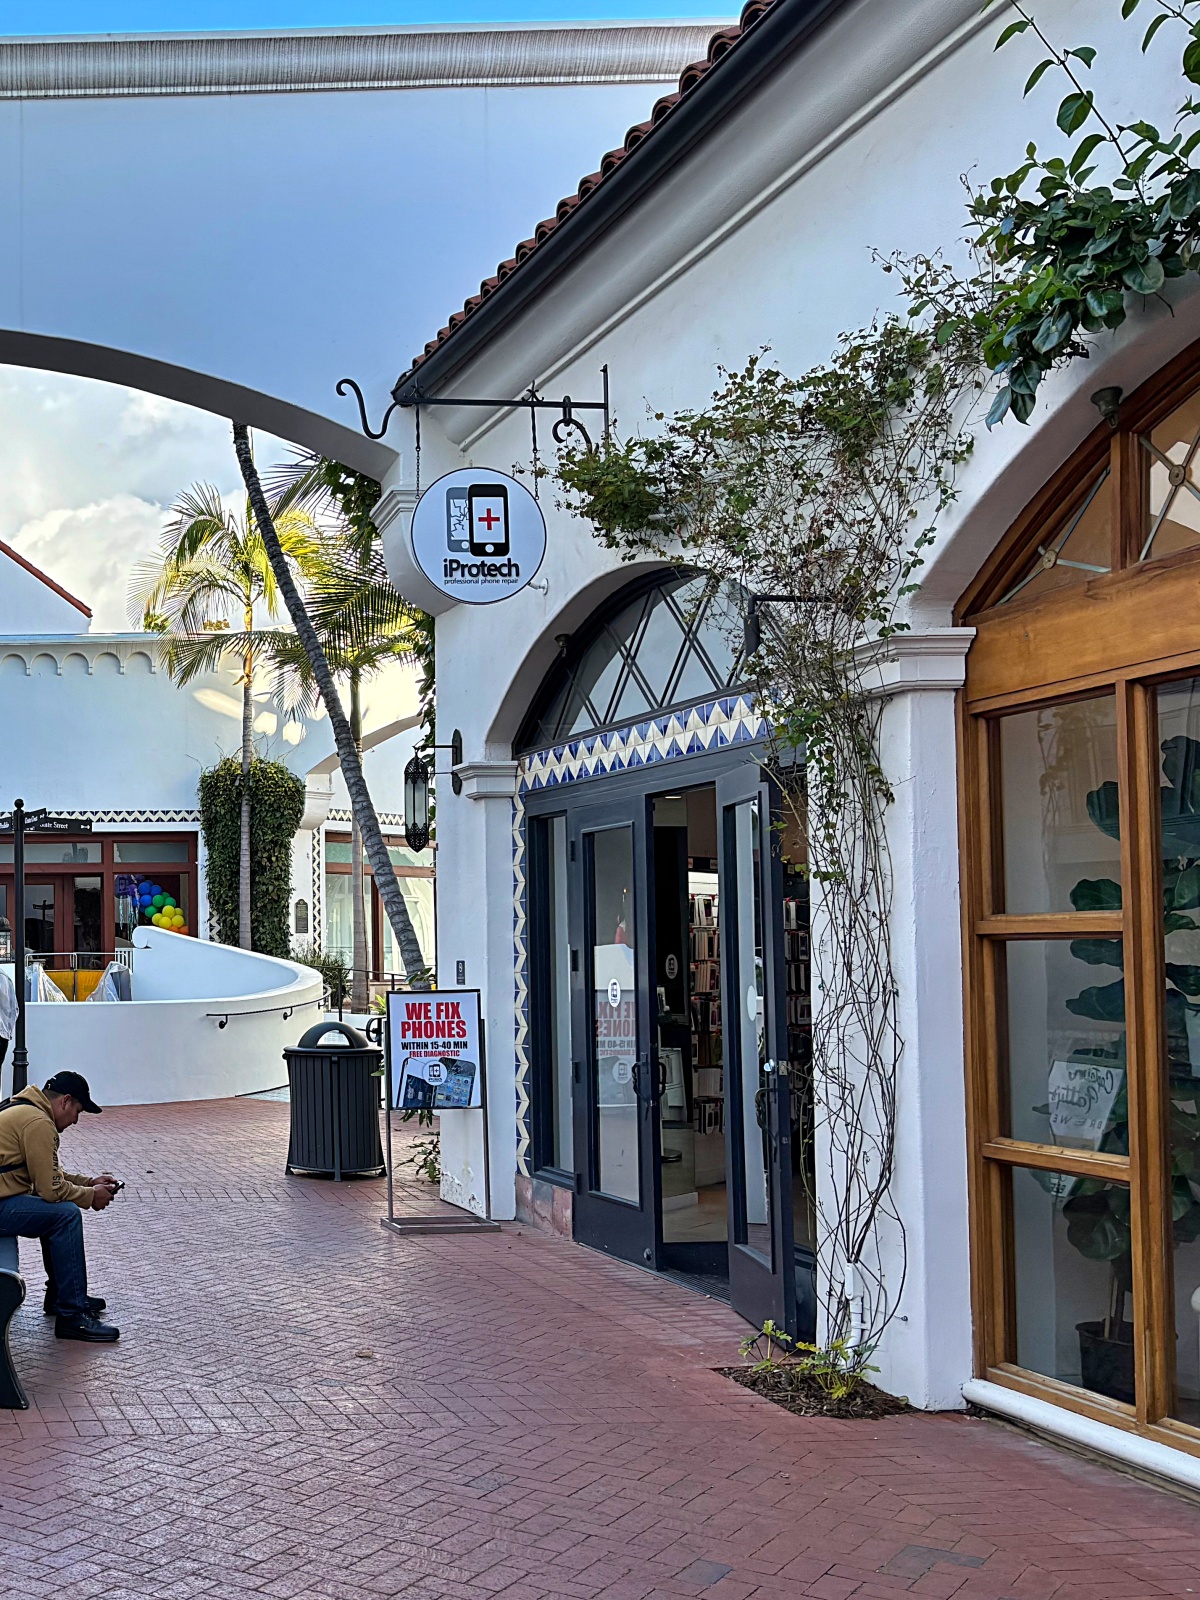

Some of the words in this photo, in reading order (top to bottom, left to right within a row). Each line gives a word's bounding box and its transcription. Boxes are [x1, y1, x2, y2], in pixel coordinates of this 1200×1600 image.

[443, 558, 520, 578] iProtech
[444, 578, 480, 586] professional
[53, 821, 69, 829] Street
[405, 1002, 432, 1020] WE
[436, 1002, 462, 1020] FIX
[401, 1020, 467, 1039] PHONES
[401, 1041, 429, 1050] WITHIN
[430, 1041, 452, 1050] 15-40
[453, 1041, 468, 1049] MIN
